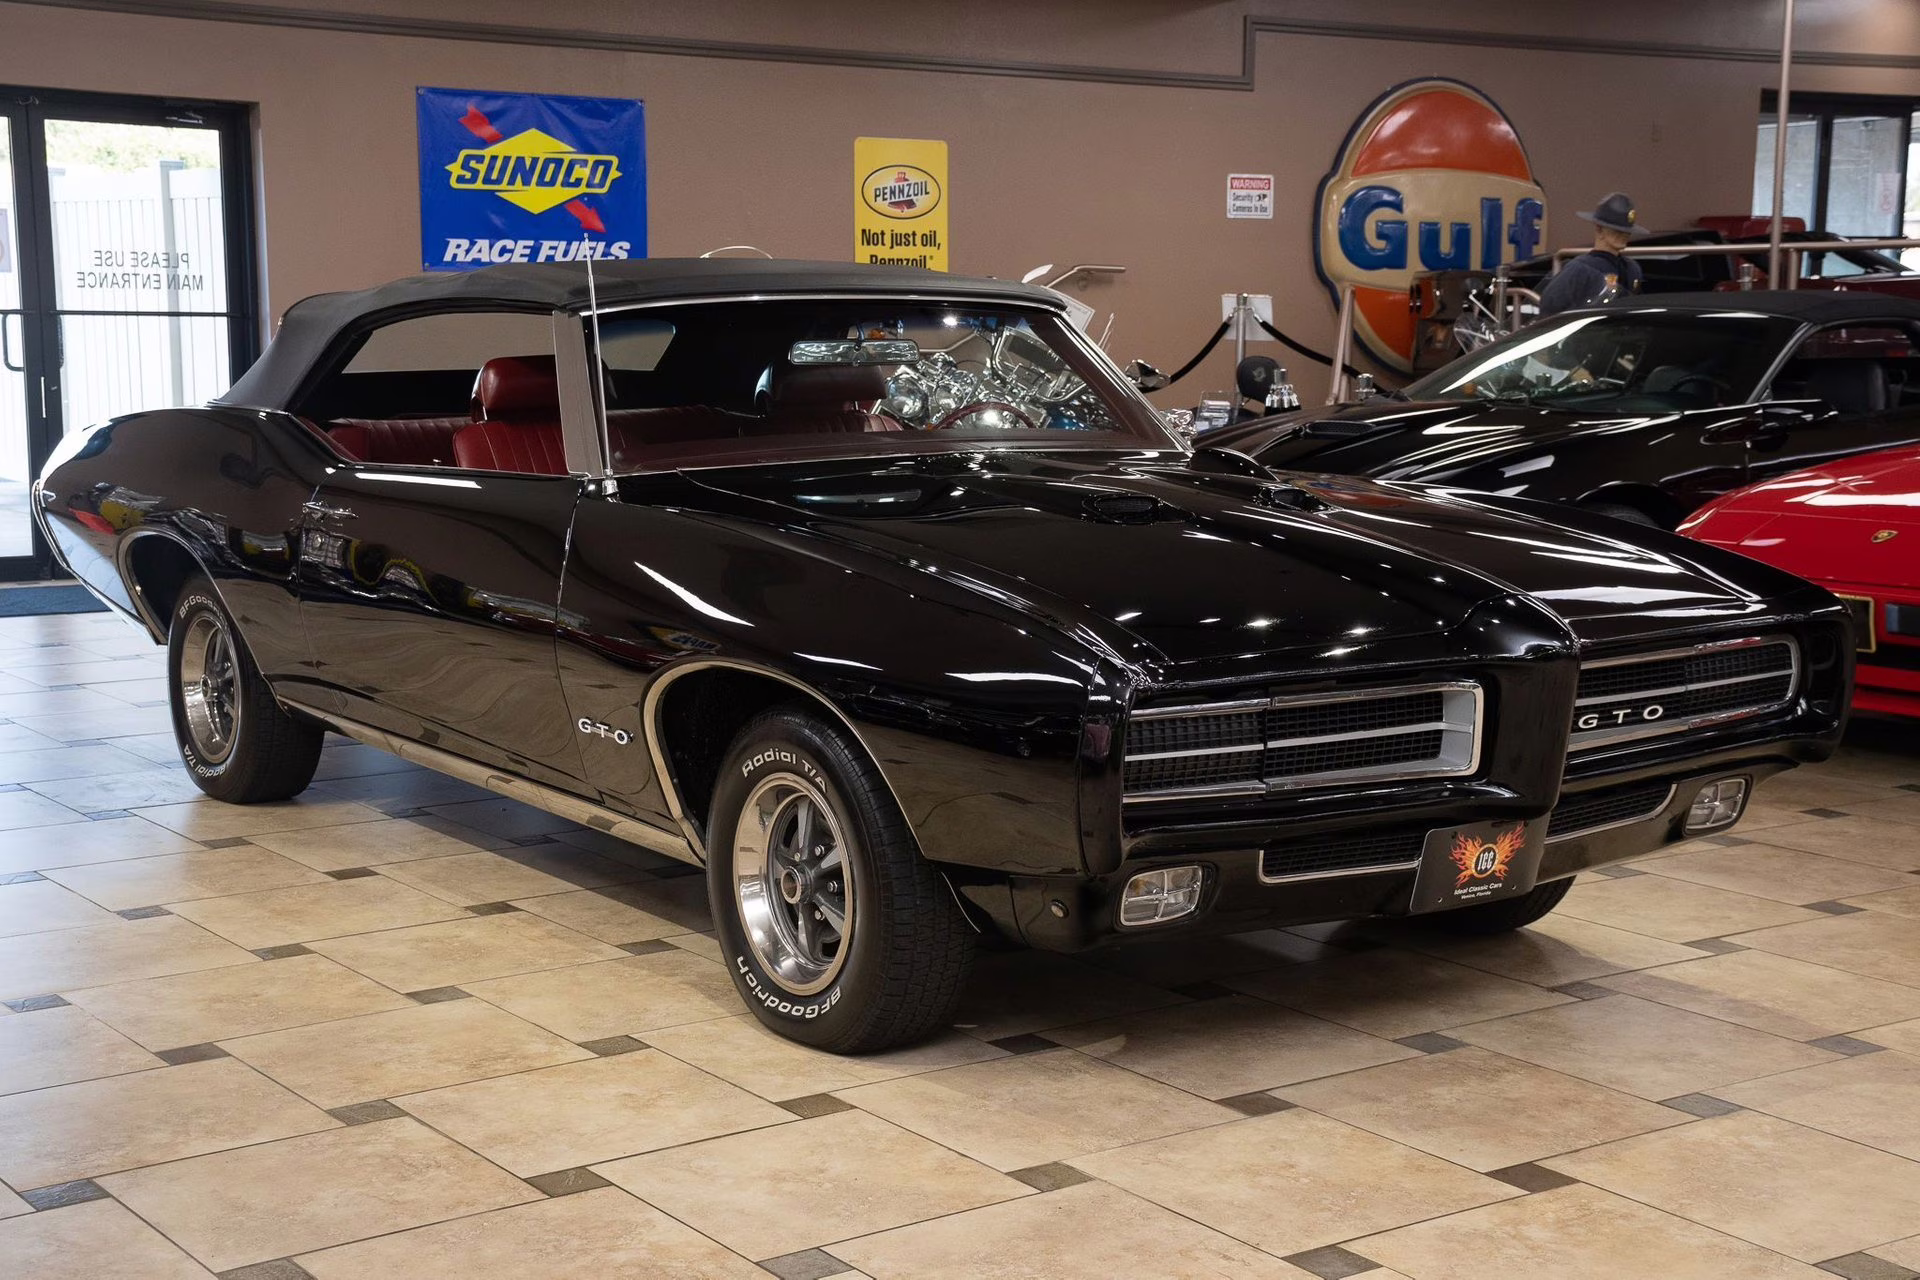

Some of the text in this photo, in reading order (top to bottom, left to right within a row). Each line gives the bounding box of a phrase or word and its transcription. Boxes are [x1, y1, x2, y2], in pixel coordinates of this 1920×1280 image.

[454, 153, 614, 190] SUNOCO
[1231, 178, 1270, 190] WARNING
[873, 180, 931, 203] PENNZOIL
[1232, 192, 1254, 204] Security
[861, 228, 942, 251] Not just oil,
[1338, 184, 1544, 272] Gulf
[443, 237, 632, 263] RACE FUELS
[578, 718, 628, 745] GTO
[741, 747, 797, 779] Radial
[1453, 882, 1503, 896] Ideal Classic Cars
[736, 955, 842, 1019] BFGoodrich
